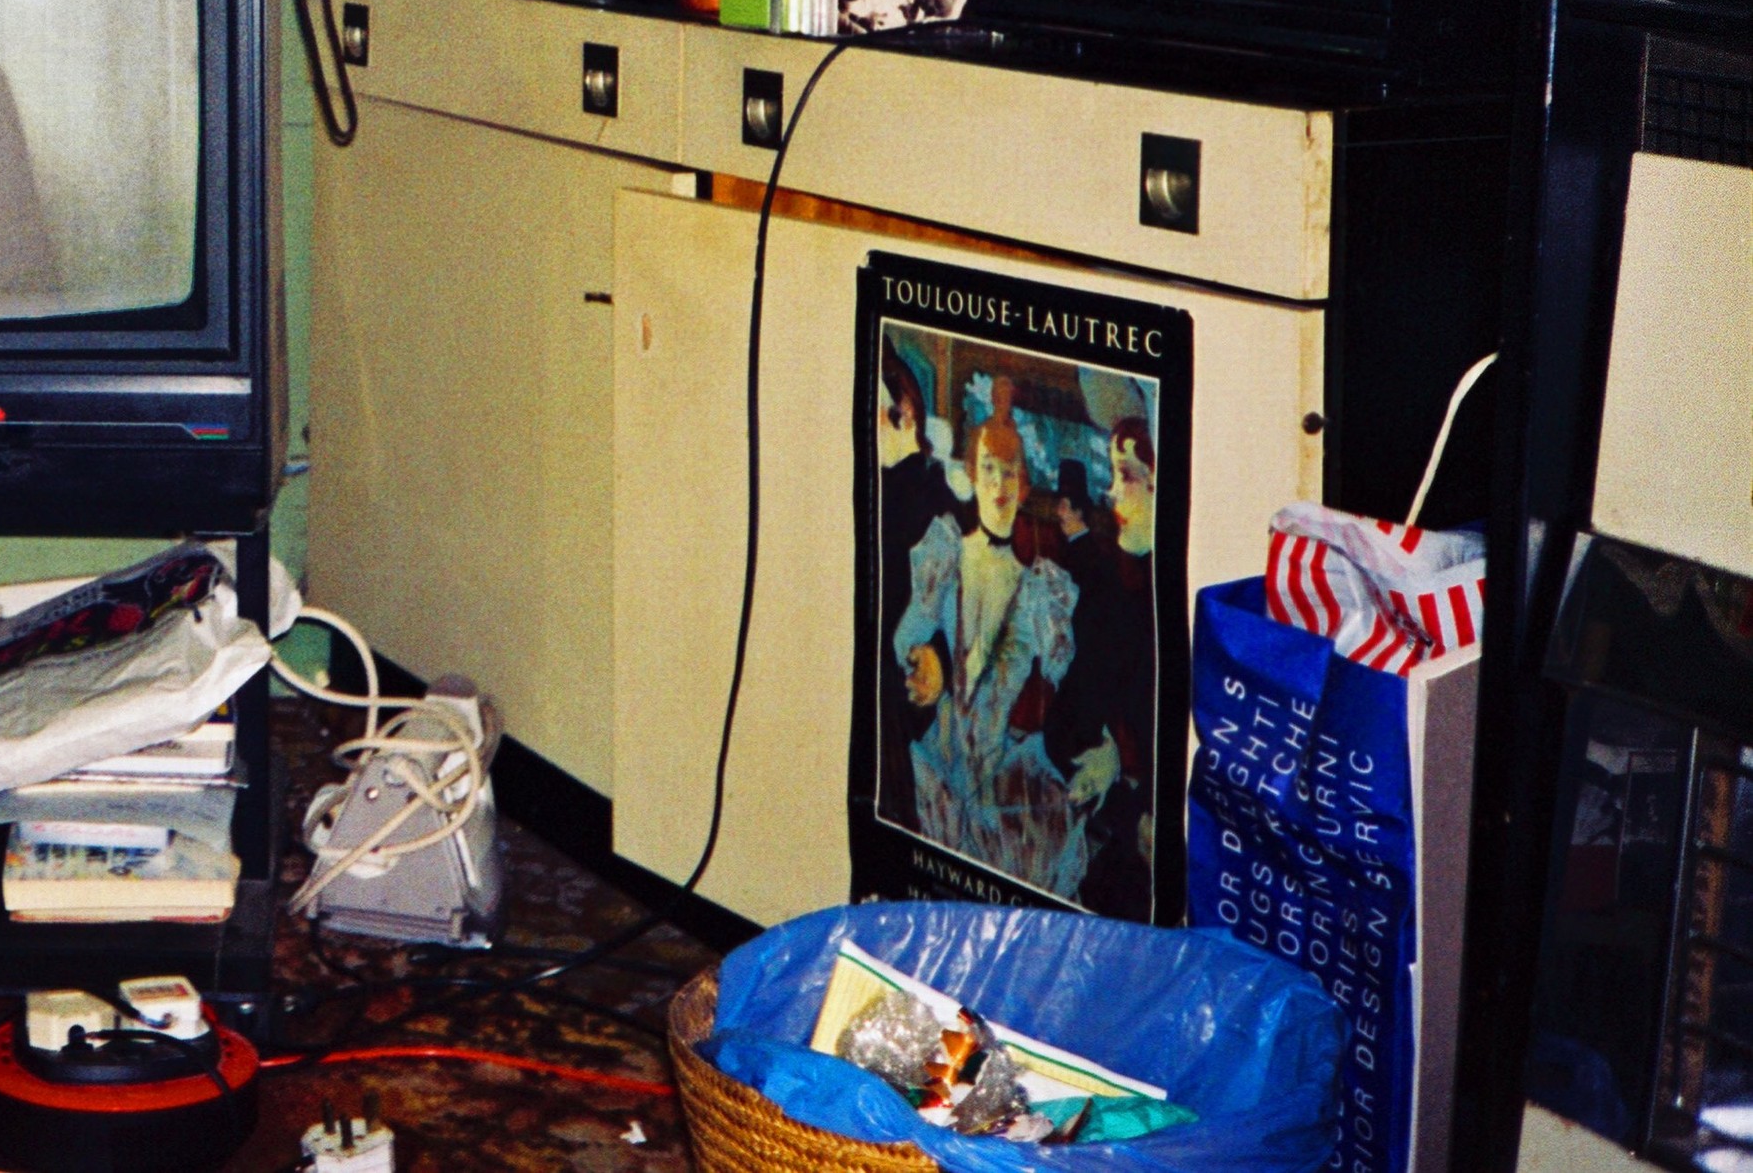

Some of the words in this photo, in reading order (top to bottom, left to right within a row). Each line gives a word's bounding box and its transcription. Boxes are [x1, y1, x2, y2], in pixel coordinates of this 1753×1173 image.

[882, 276, 1163, 358] TOULOUSE-LAUTREC
[913, 850, 1002, 906] HAYWARD
[1355, 908, 1389, 1072] DESIGN
